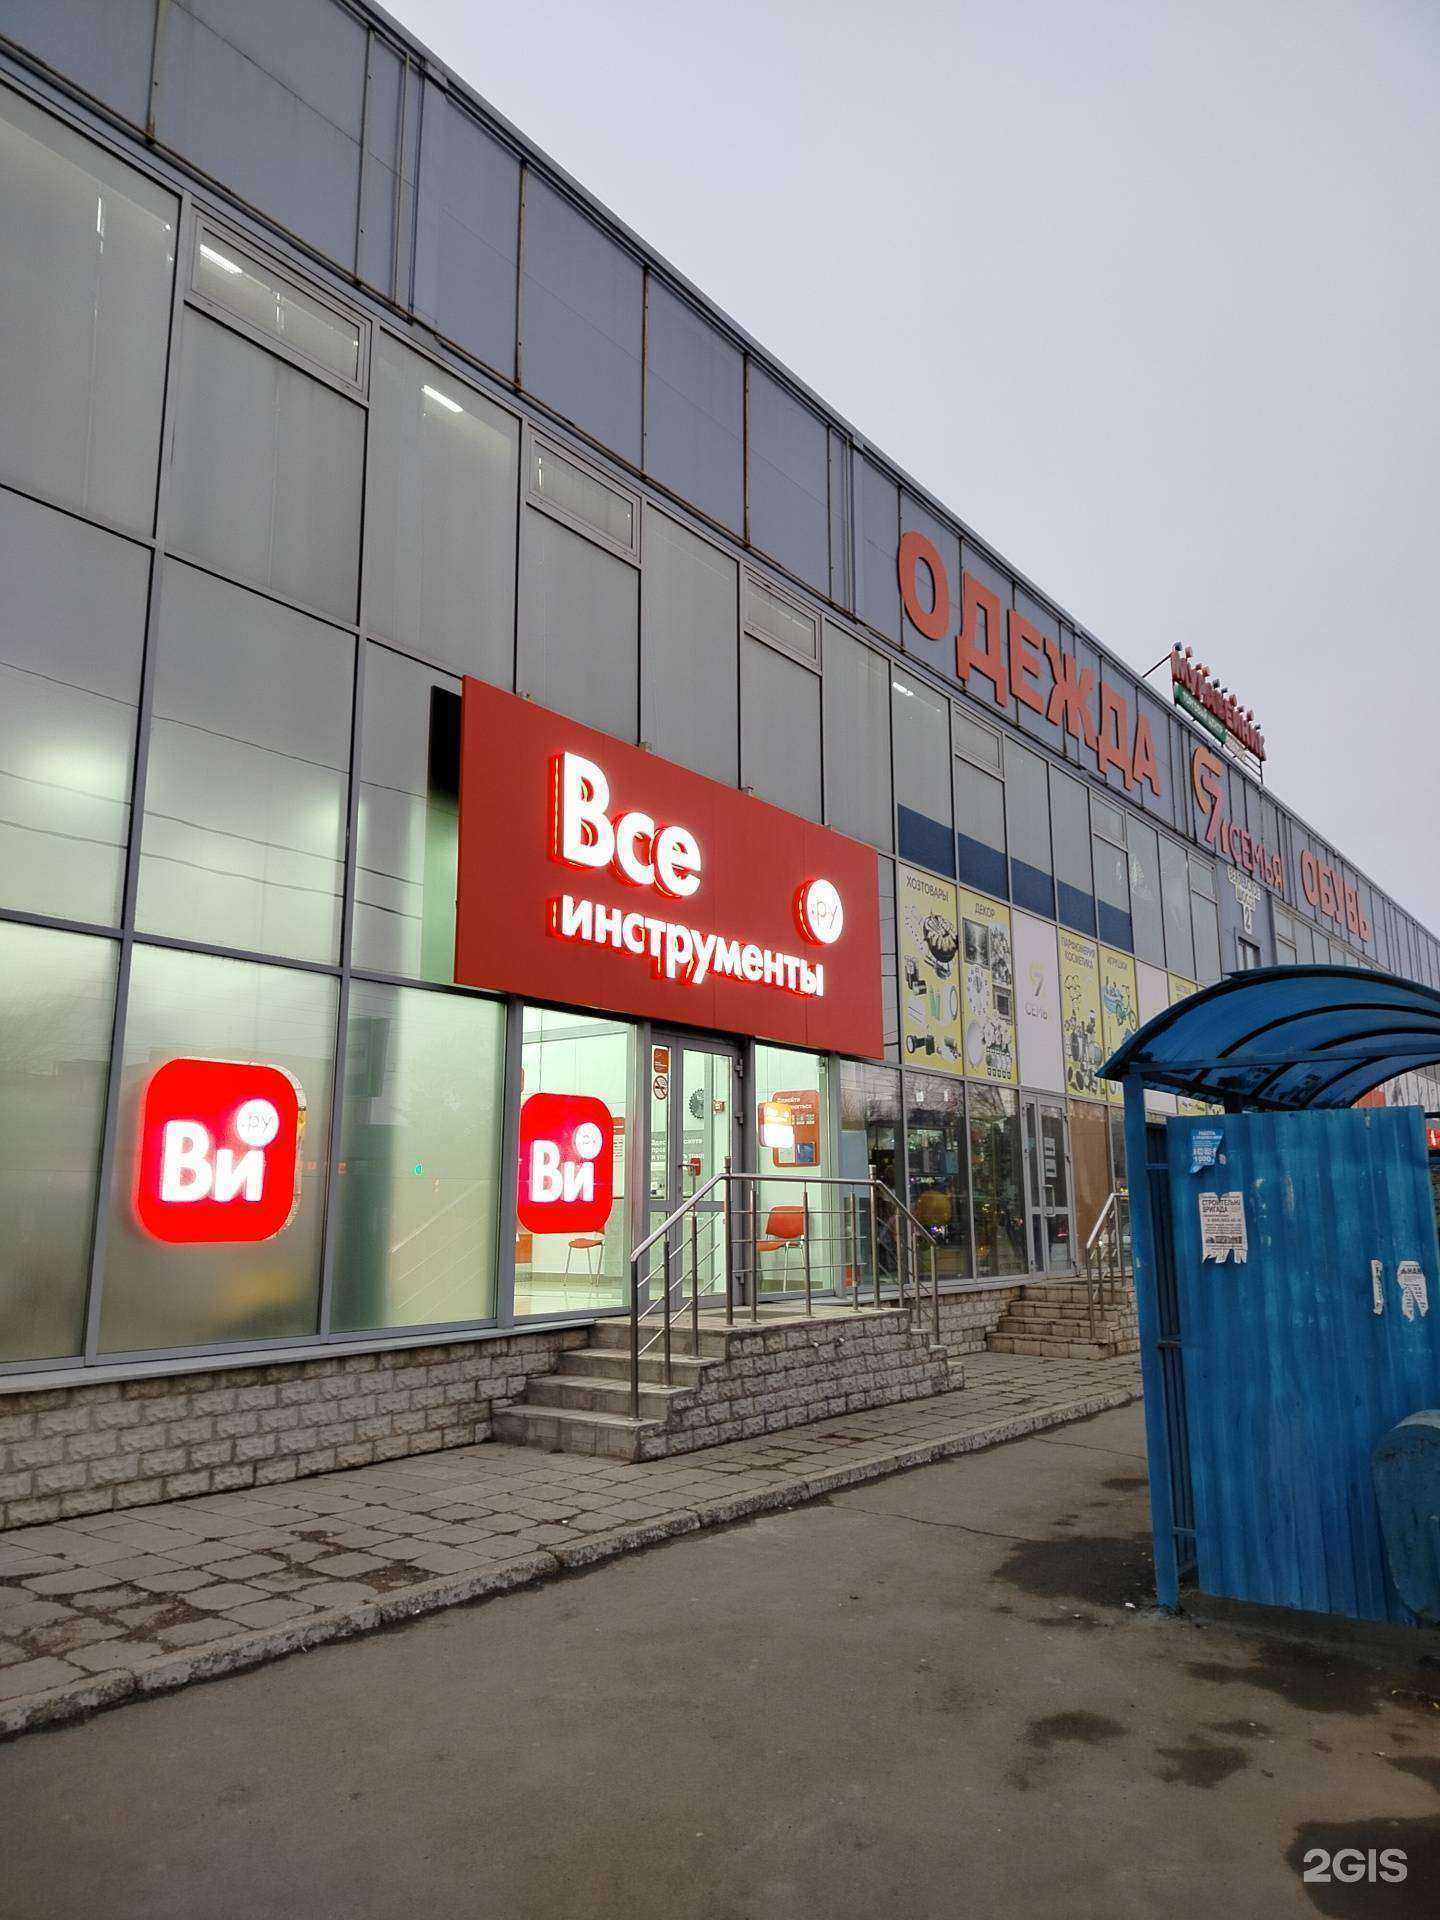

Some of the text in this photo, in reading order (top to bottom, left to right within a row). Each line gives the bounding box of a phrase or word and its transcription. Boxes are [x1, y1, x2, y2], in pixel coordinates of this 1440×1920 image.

[898, 530, 1162, 799] ОДЕЖДА
[561, 750, 702, 898] Все
[1229, 824, 1284, 894] СЕМЬЯ
[905, 875, 950, 902] ХОЗТОВАРЫ
[1301, 848, 1371, 943] ОБУВЬ
[560, 894, 825, 998] инструменты
